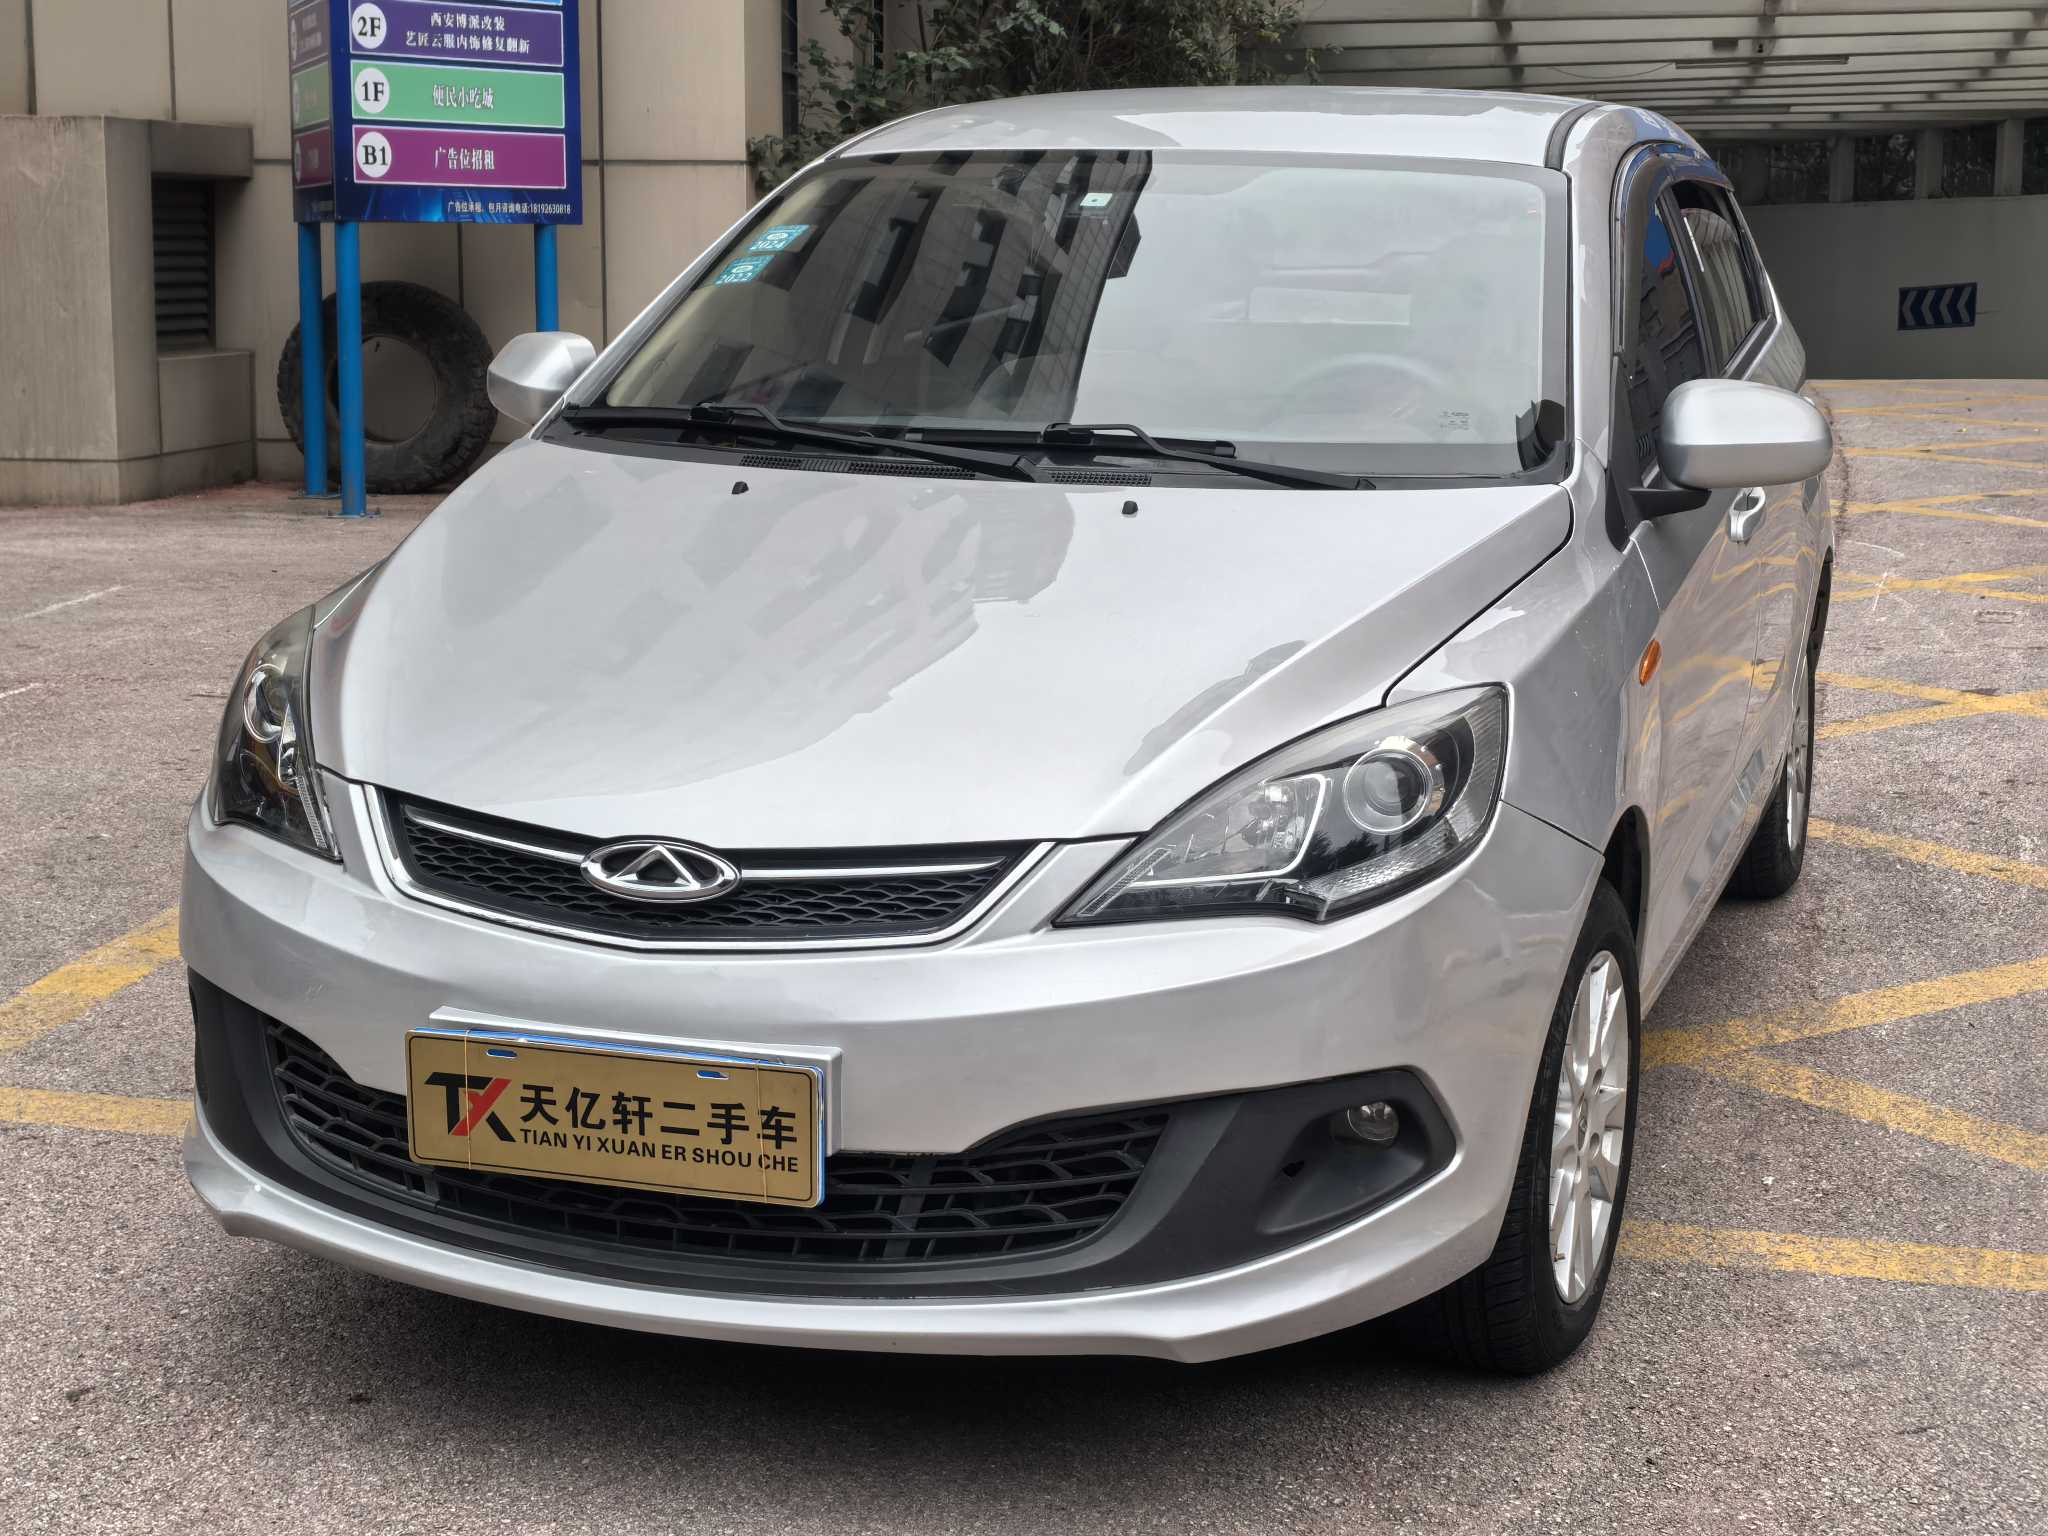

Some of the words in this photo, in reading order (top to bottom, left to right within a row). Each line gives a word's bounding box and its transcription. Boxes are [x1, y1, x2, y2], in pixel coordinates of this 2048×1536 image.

[357, 16, 381, 37] 2F
[361, 81, 385, 102] 1F
[432, 84, 494, 109] 便民小吃城
[362, 145, 388, 166] B1
[434, 147, 495, 170] 广告位招租
[520, 1083, 798, 1150] 天亿轩二手车
[519, 1128, 567, 1148] TIAN
[573, 1133, 591, 1151] YI
[596, 1136, 656, 1159] XUAN
[661, 1144, 687, 1162] ER
[691, 1147, 752, 1168] SHOU
[758, 1153, 799, 1173] CHE
